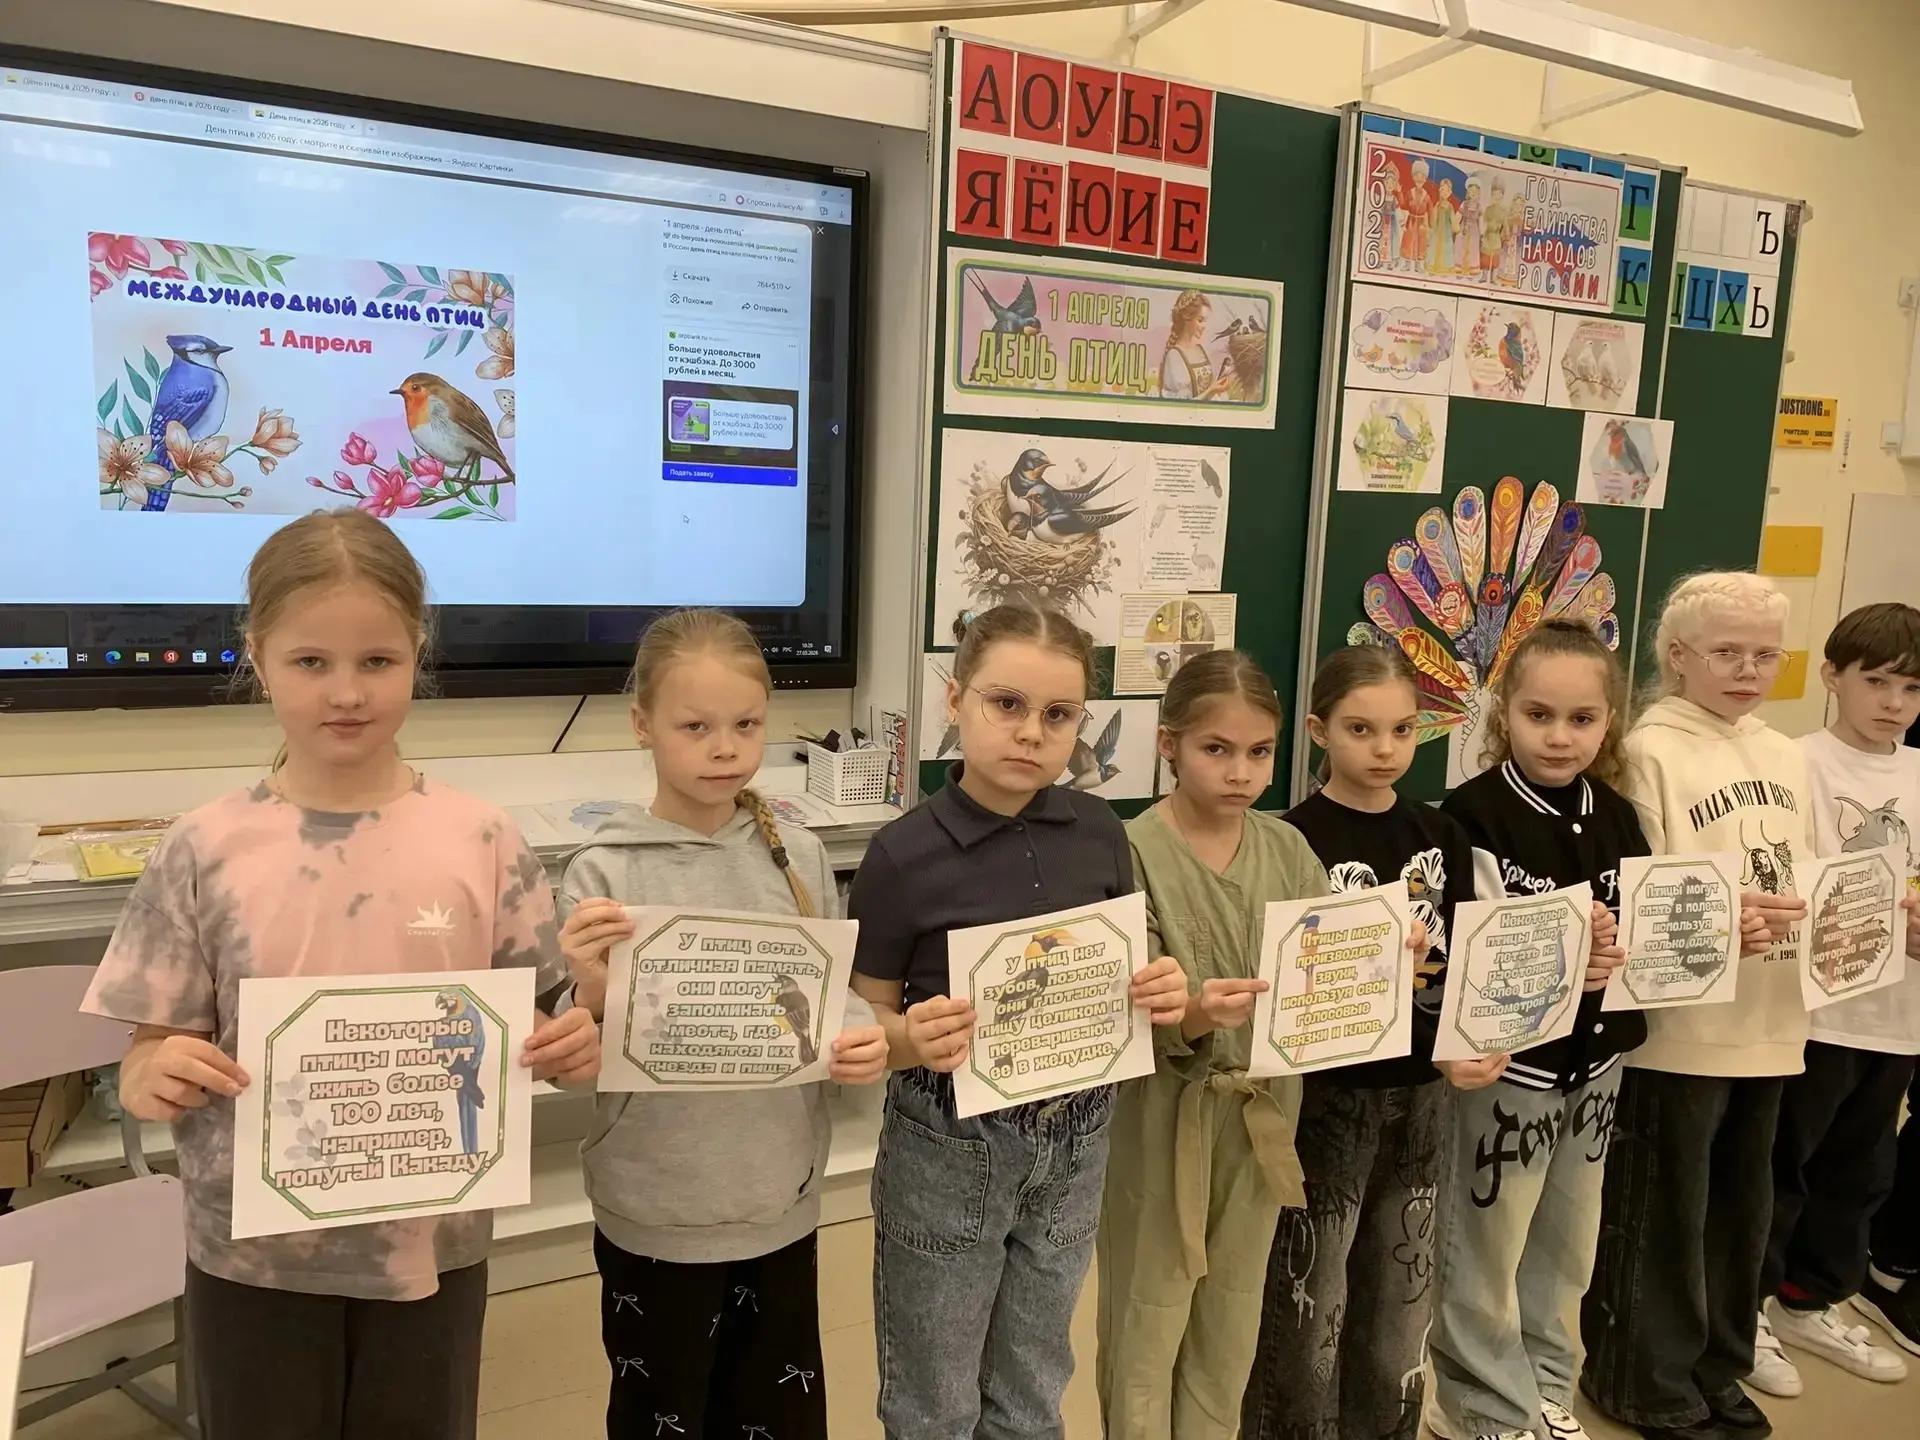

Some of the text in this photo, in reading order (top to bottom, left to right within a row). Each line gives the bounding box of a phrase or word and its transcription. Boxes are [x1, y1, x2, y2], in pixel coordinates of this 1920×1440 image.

[313, 117, 329, 127] 2026
[964, 64, 1203, 154] А О У Ы Э
[205, 124, 227, 134] День
[228, 128, 249, 138] птиц
[257, 131, 276, 141] 2026
[391, 150, 442, 163] изображения
[479, 162, 514, 173] Картинки
[1524, 175, 1562, 209] ГОД
[961, 164, 1201, 254] Я Ё Ю И Е
[1363, 149, 1387, 270] 2026
[1625, 184, 1649, 231] Г
[672, 222, 700, 231] апреля
[704, 226, 723, 235] день
[1524, 207, 1608, 243] ЕДИНСТВА
[1756, 211, 1779, 255] Ъ
[1521, 239, 1597, 270] НАРОДОВ
[683, 273, 710, 282] Скачать
[1516, 263, 1599, 300] РОССИИ
[1617, 259, 1647, 307] К
[128, 279, 485, 329] МЕЖДУНАРОДНЫЙ ДЕНЬ ПТИЦ
[683, 297, 788, 313] Похожие Отправить
[1048, 289, 1150, 330] 1 АПРЕЛЯ
[1687, 277, 1714, 329] Ц
[1718, 282, 1745, 326] Х
[1749, 287, 1770, 329] Ь
[260, 327, 372, 354] 1 Апреля
[669, 344, 761, 359] Больше удовольствия
[669, 366, 736, 378] рублей месяц.
[680, 357, 718, 366] кэшбэка.
[719, 359, 732, 368] До
[733, 360, 756, 369] 3000
[974, 329, 1149, 393] ДЕНЬ ПТИЦ
[670, 469, 714, 478] Подать заявку
[1689, 786, 1734, 832] WALK
[1731, 781, 1769, 807] WITH
[1645, 882, 1719, 899] Птицы могут
[1838, 869, 1872, 887] Птицы
[1830, 885, 1879, 907] являются
[1500, 907, 1568, 928] Некоторые
[1638, 904, 1672, 917] спать
[1675, 903, 1683, 914] в
[1815, 899, 1893, 929] единственными
[1301, 922, 1392, 949] Птицы могут
[1486, 924, 1568, 947] птицы могут
[1652, 918, 1713, 934] используя
[678, 932, 807, 956] У птиц есть
[1025, 950, 1069, 971] птиц
[1074, 942, 1106, 961] нет
[1493, 944, 1557, 964] летать на
[1644, 935, 1717, 952] только одну
[1780, 949, 1797, 960] 1991
[1813, 935, 1890, 965] которые могут
[639, 959, 823, 979] отличная память,
[1296, 943, 1383, 973] производить
[1628, 952, 1725, 970] половину своего
[983, 959, 1122, 1001] зубов, поэтому
[1315, 966, 1358, 985] звуки,
[1487, 960, 1558, 985] расстояние
[677, 981, 783, 1000] они могут
[995, 982, 1110, 1016] они глотают
[1281, 979, 1389, 1011] используя свои
[1480, 985, 1520, 1000] более
[1536, 974, 1559, 991] 000
[667, 1003, 787, 1018] запоминать
[1296, 1002, 1371, 1027] голосовые
[1470, 992, 1561, 1018] километров во
[326, 1018, 472, 1043] Некоторые
[669, 1023, 782, 1041] места, где
[979, 999, 1124, 1039] пищу целиком и
[1499, 1015, 1536, 1033] время
[989, 1020, 1115, 1059] переваривают
[1279, 1019, 1384, 1049] связки и клюв.
[300, 1046, 476, 1073] птицы могут
[649, 1043, 796, 1058] находятся их
[989, 1042, 1118, 1081] ее в желудке.
[644, 1061, 793, 1075] гнезда и пища.
[310, 1070, 464, 1100] жить более
[331, 1101, 443, 1126] 100 лет,
[321, 1127, 452, 1156] например,
[275, 1151, 491, 1190] попугай Какаду.
